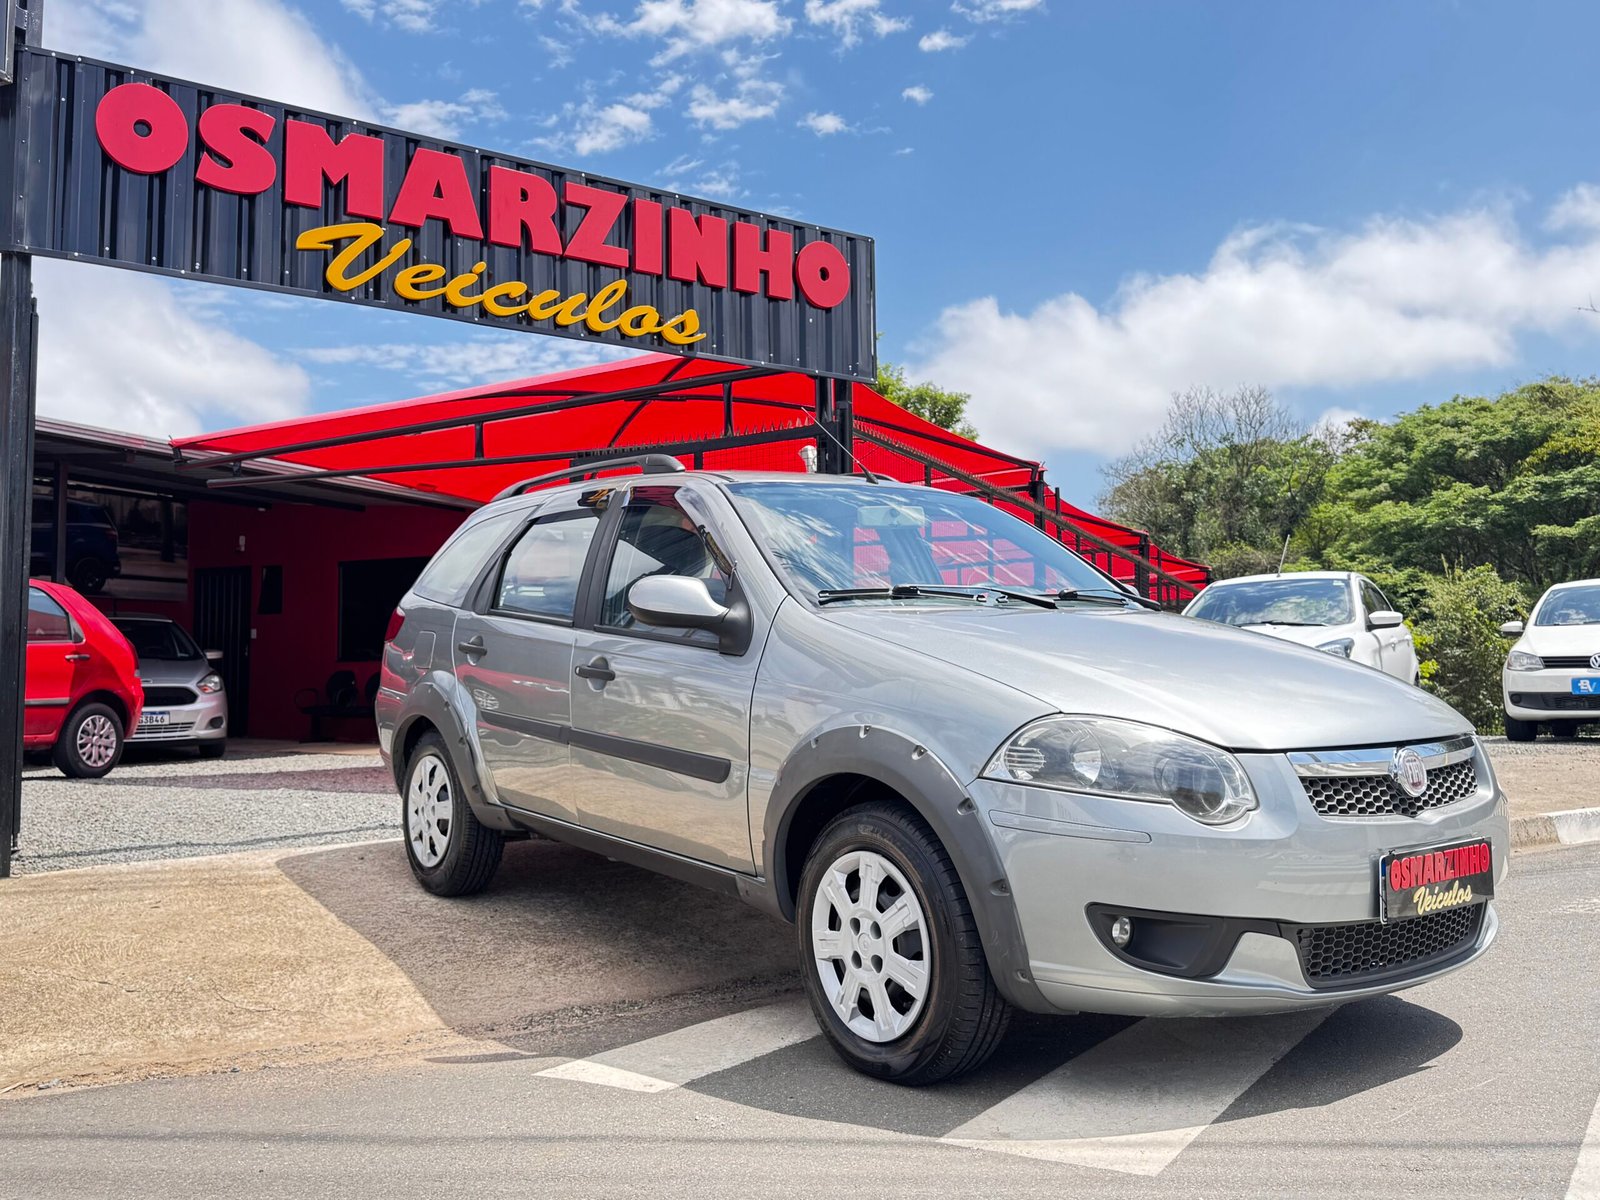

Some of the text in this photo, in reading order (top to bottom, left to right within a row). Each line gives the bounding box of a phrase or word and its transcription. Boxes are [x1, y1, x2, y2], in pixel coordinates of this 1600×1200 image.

[95, 83, 851, 309] OSMARZINHO
[296, 222, 707, 346] Veiculos
[1390, 843, 1490, 891] OSMARZINHO
[1413, 880, 1473, 915] Veiculos
